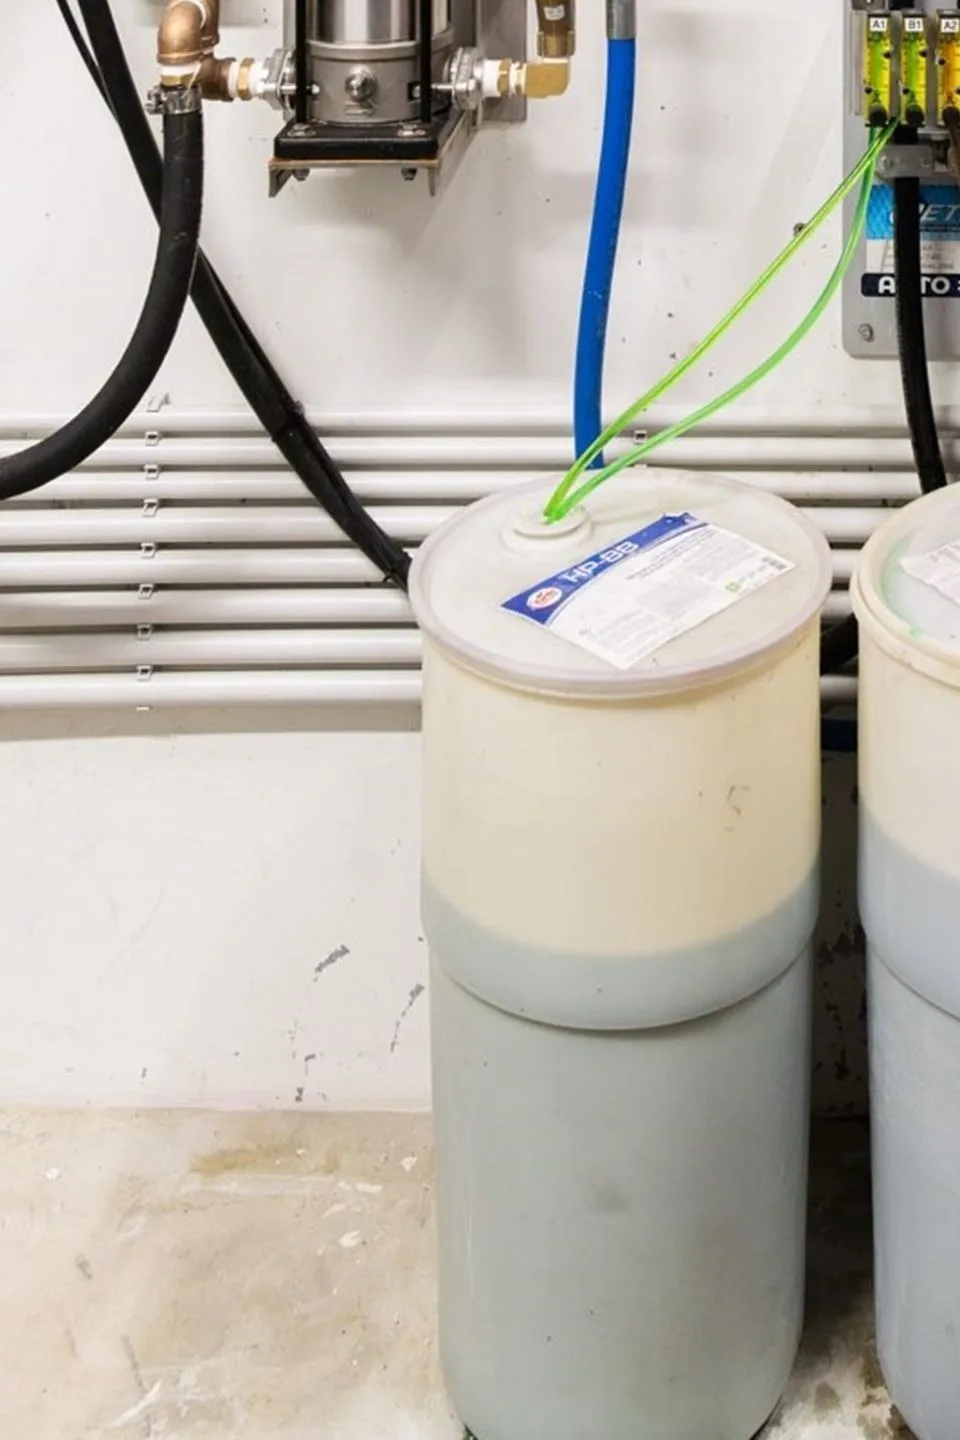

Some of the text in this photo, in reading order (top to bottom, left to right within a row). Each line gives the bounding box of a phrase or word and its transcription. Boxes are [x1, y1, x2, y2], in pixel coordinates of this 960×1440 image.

[872, 19, 885, 29] A1
[908, 19, 921, 29] B1
[943, 20, 957, 30] A2
[878, 275, 951, 294] ATO
